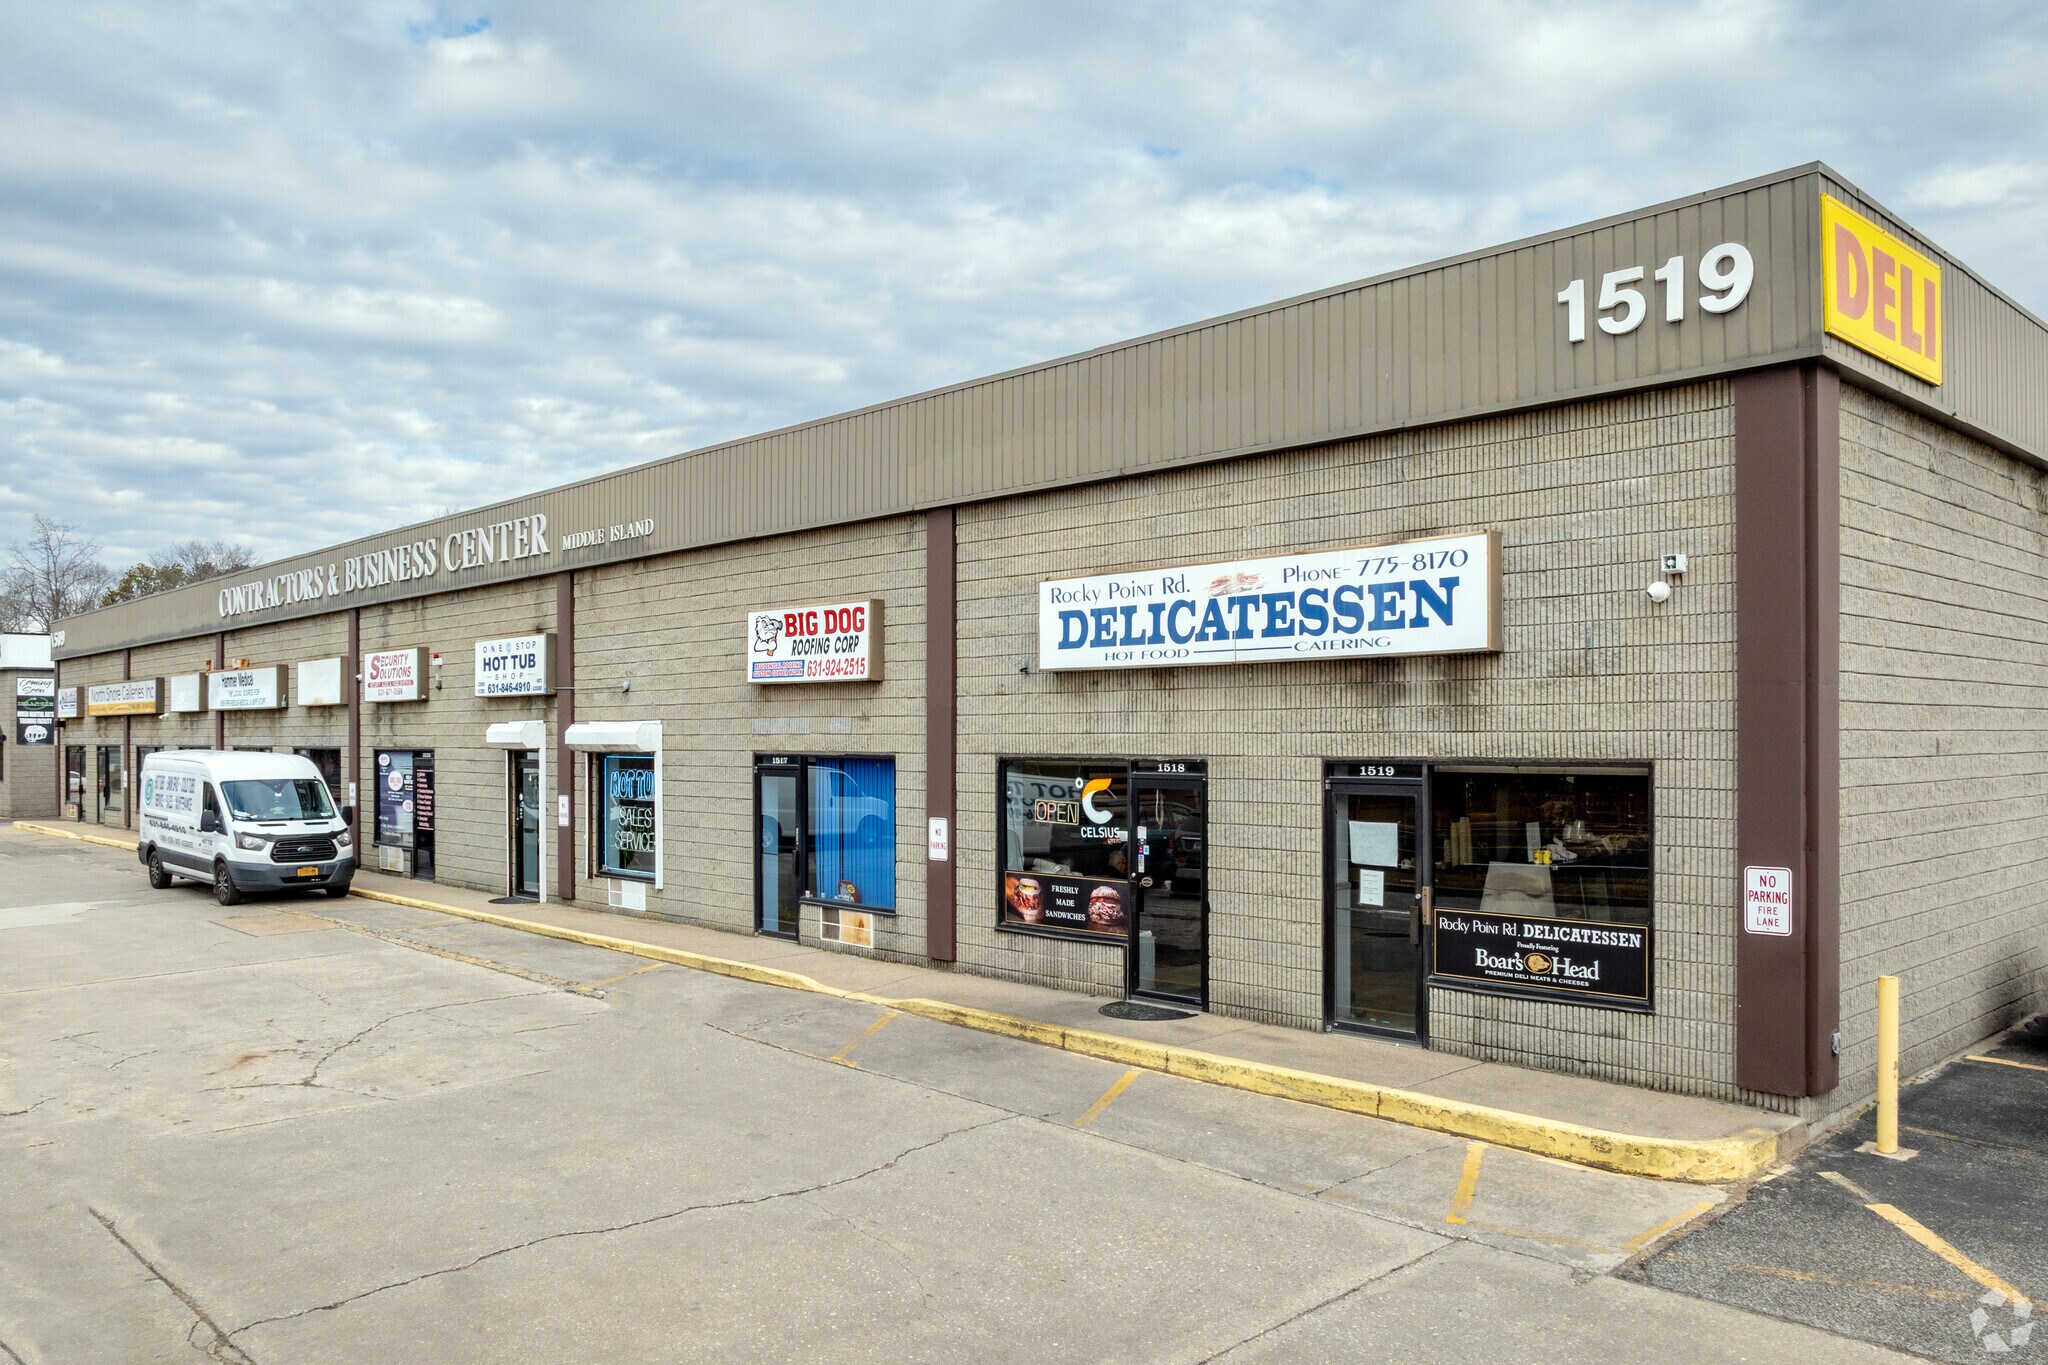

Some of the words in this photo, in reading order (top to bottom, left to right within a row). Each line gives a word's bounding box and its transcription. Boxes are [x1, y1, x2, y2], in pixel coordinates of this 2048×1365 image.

[1556, 241, 1755, 343] 1519
[1834, 221, 1936, 362] DELI
[562, 528, 605, 551] MIDDLE
[610, 518, 655, 542] ISLAND
[218, 565, 324, 618] CONTRACTORS
[327, 563, 340, 597] &
[344, 537, 438, 593] BUSINESS
[444, 513, 551, 572] CENTER
[1356, 549, 1469, 577] 775-8170
[1051, 584, 1101, 605] Rocky
[1162, 573, 1191, 595] Rd.
[1057, 575, 1460, 650] DELICATESSEN
[783, 610, 819, 638] BIG
[823, 606, 866, 635] DOG
[483, 644, 503, 653] ONE
[515, 640, 537, 651] STOP
[791, 637, 831, 656] ROOFING
[834, 635, 860, 654] CORP
[1294, 636, 1392, 652] CATERING
[483, 655, 509, 672] HOT
[511, 653, 537, 670] TUB
[1105, 651, 1136, 662] HOT
[1141, 648, 1190, 660] FOOD
[806, 657, 866, 677] 631-924-2515
[19, 679, 53, 689] Coming
[495, 672, 524, 681] SHOP
[487, 681, 531, 694] 631-846-4910
[772, 757, 788, 765] 1517
[1157, 763, 1186, 773] 1518
[1359, 765, 1395, 777] 1519
[610, 769, 635, 799] HOT
[636, 769, 655, 800] TU
[619, 806, 653, 829] SALES
[1036, 801, 1077, 823] OPEN
[1080, 826, 1120, 838] CELSIUS
[614, 830, 655, 853] SERVICE
[1759, 874, 1777, 888] NO
[1051, 884, 1079, 895] FRESHLY
[1748, 890, 1788, 905] PARKING
[1055, 898, 1075, 907] MADE
[1758, 905, 1778, 916] FIRE
[1045, 909, 1086, 921] SANDWICHES
[1756, 917, 1780, 927] LANE
[1439, 916, 1470, 934] Rocky
[1502, 922, 1521, 937] Rd.
[1522, 923, 1642, 948] DELICATESSEN
[1516, 941, 1535, 951] Proudly
[1535, 943, 1559, 953] Featuring
[1475, 947, 1524, 971] Boar's
[1551, 956, 1600, 981] Head
[1484, 970, 1514, 978] PREMIUM
[1530, 974, 1551, 982] MEATS
[1558, 978, 1590, 987] CHEESES
